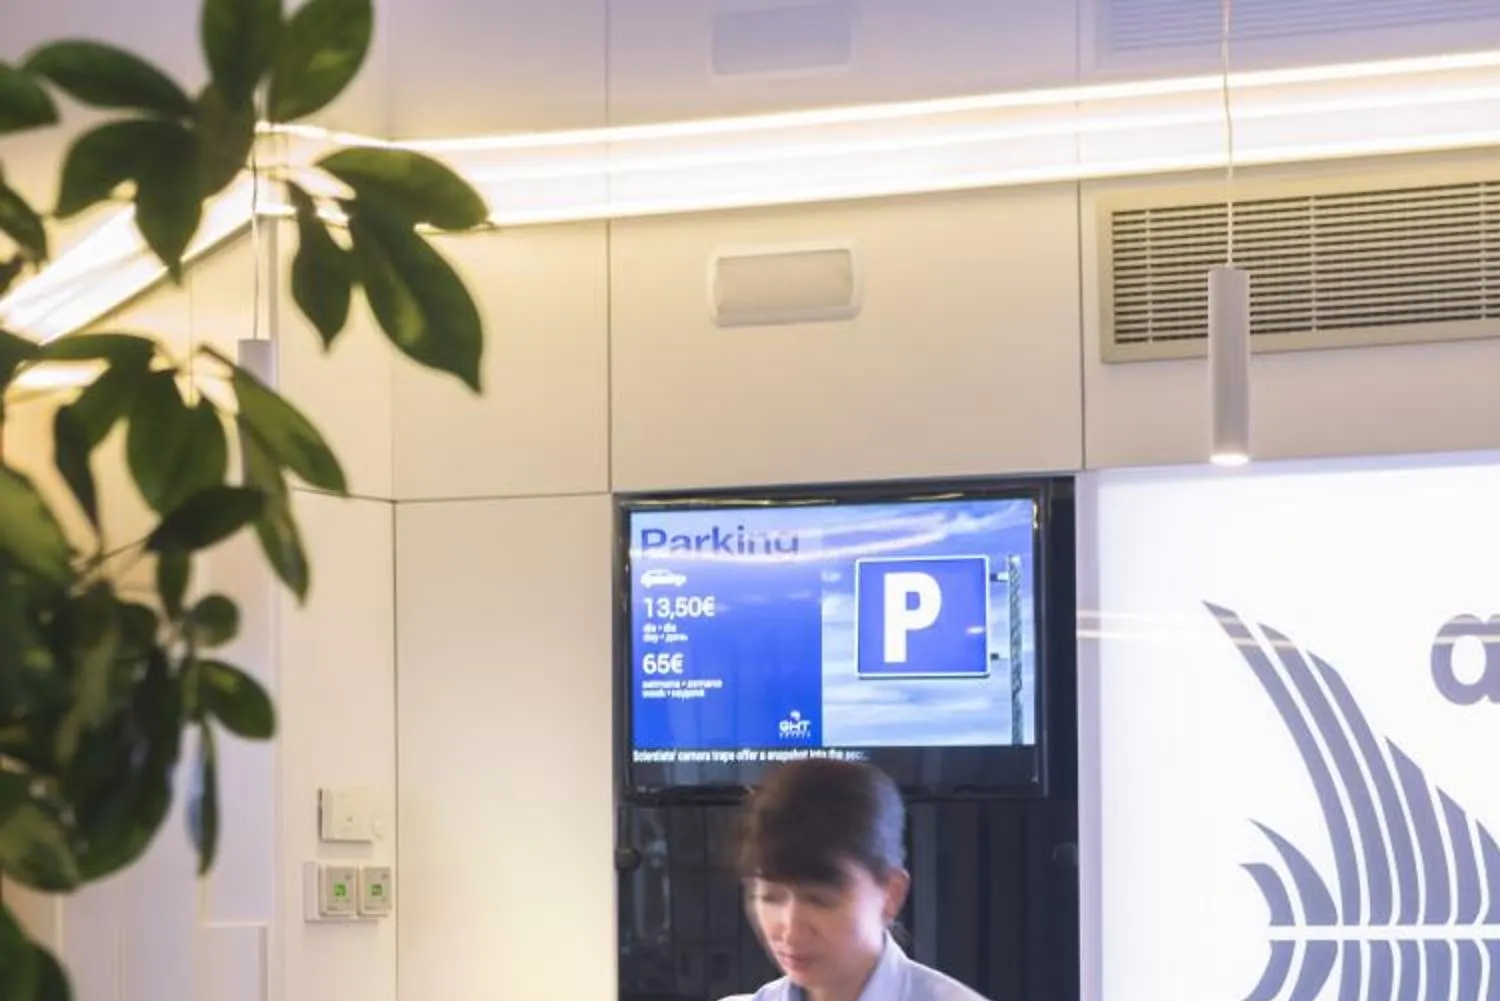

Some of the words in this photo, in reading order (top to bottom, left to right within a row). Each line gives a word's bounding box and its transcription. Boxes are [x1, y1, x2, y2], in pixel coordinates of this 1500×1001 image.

[643, 595, 716, 620] 13,50€
[883, 571, 943, 664] P
[642, 652, 685, 675] 65€
